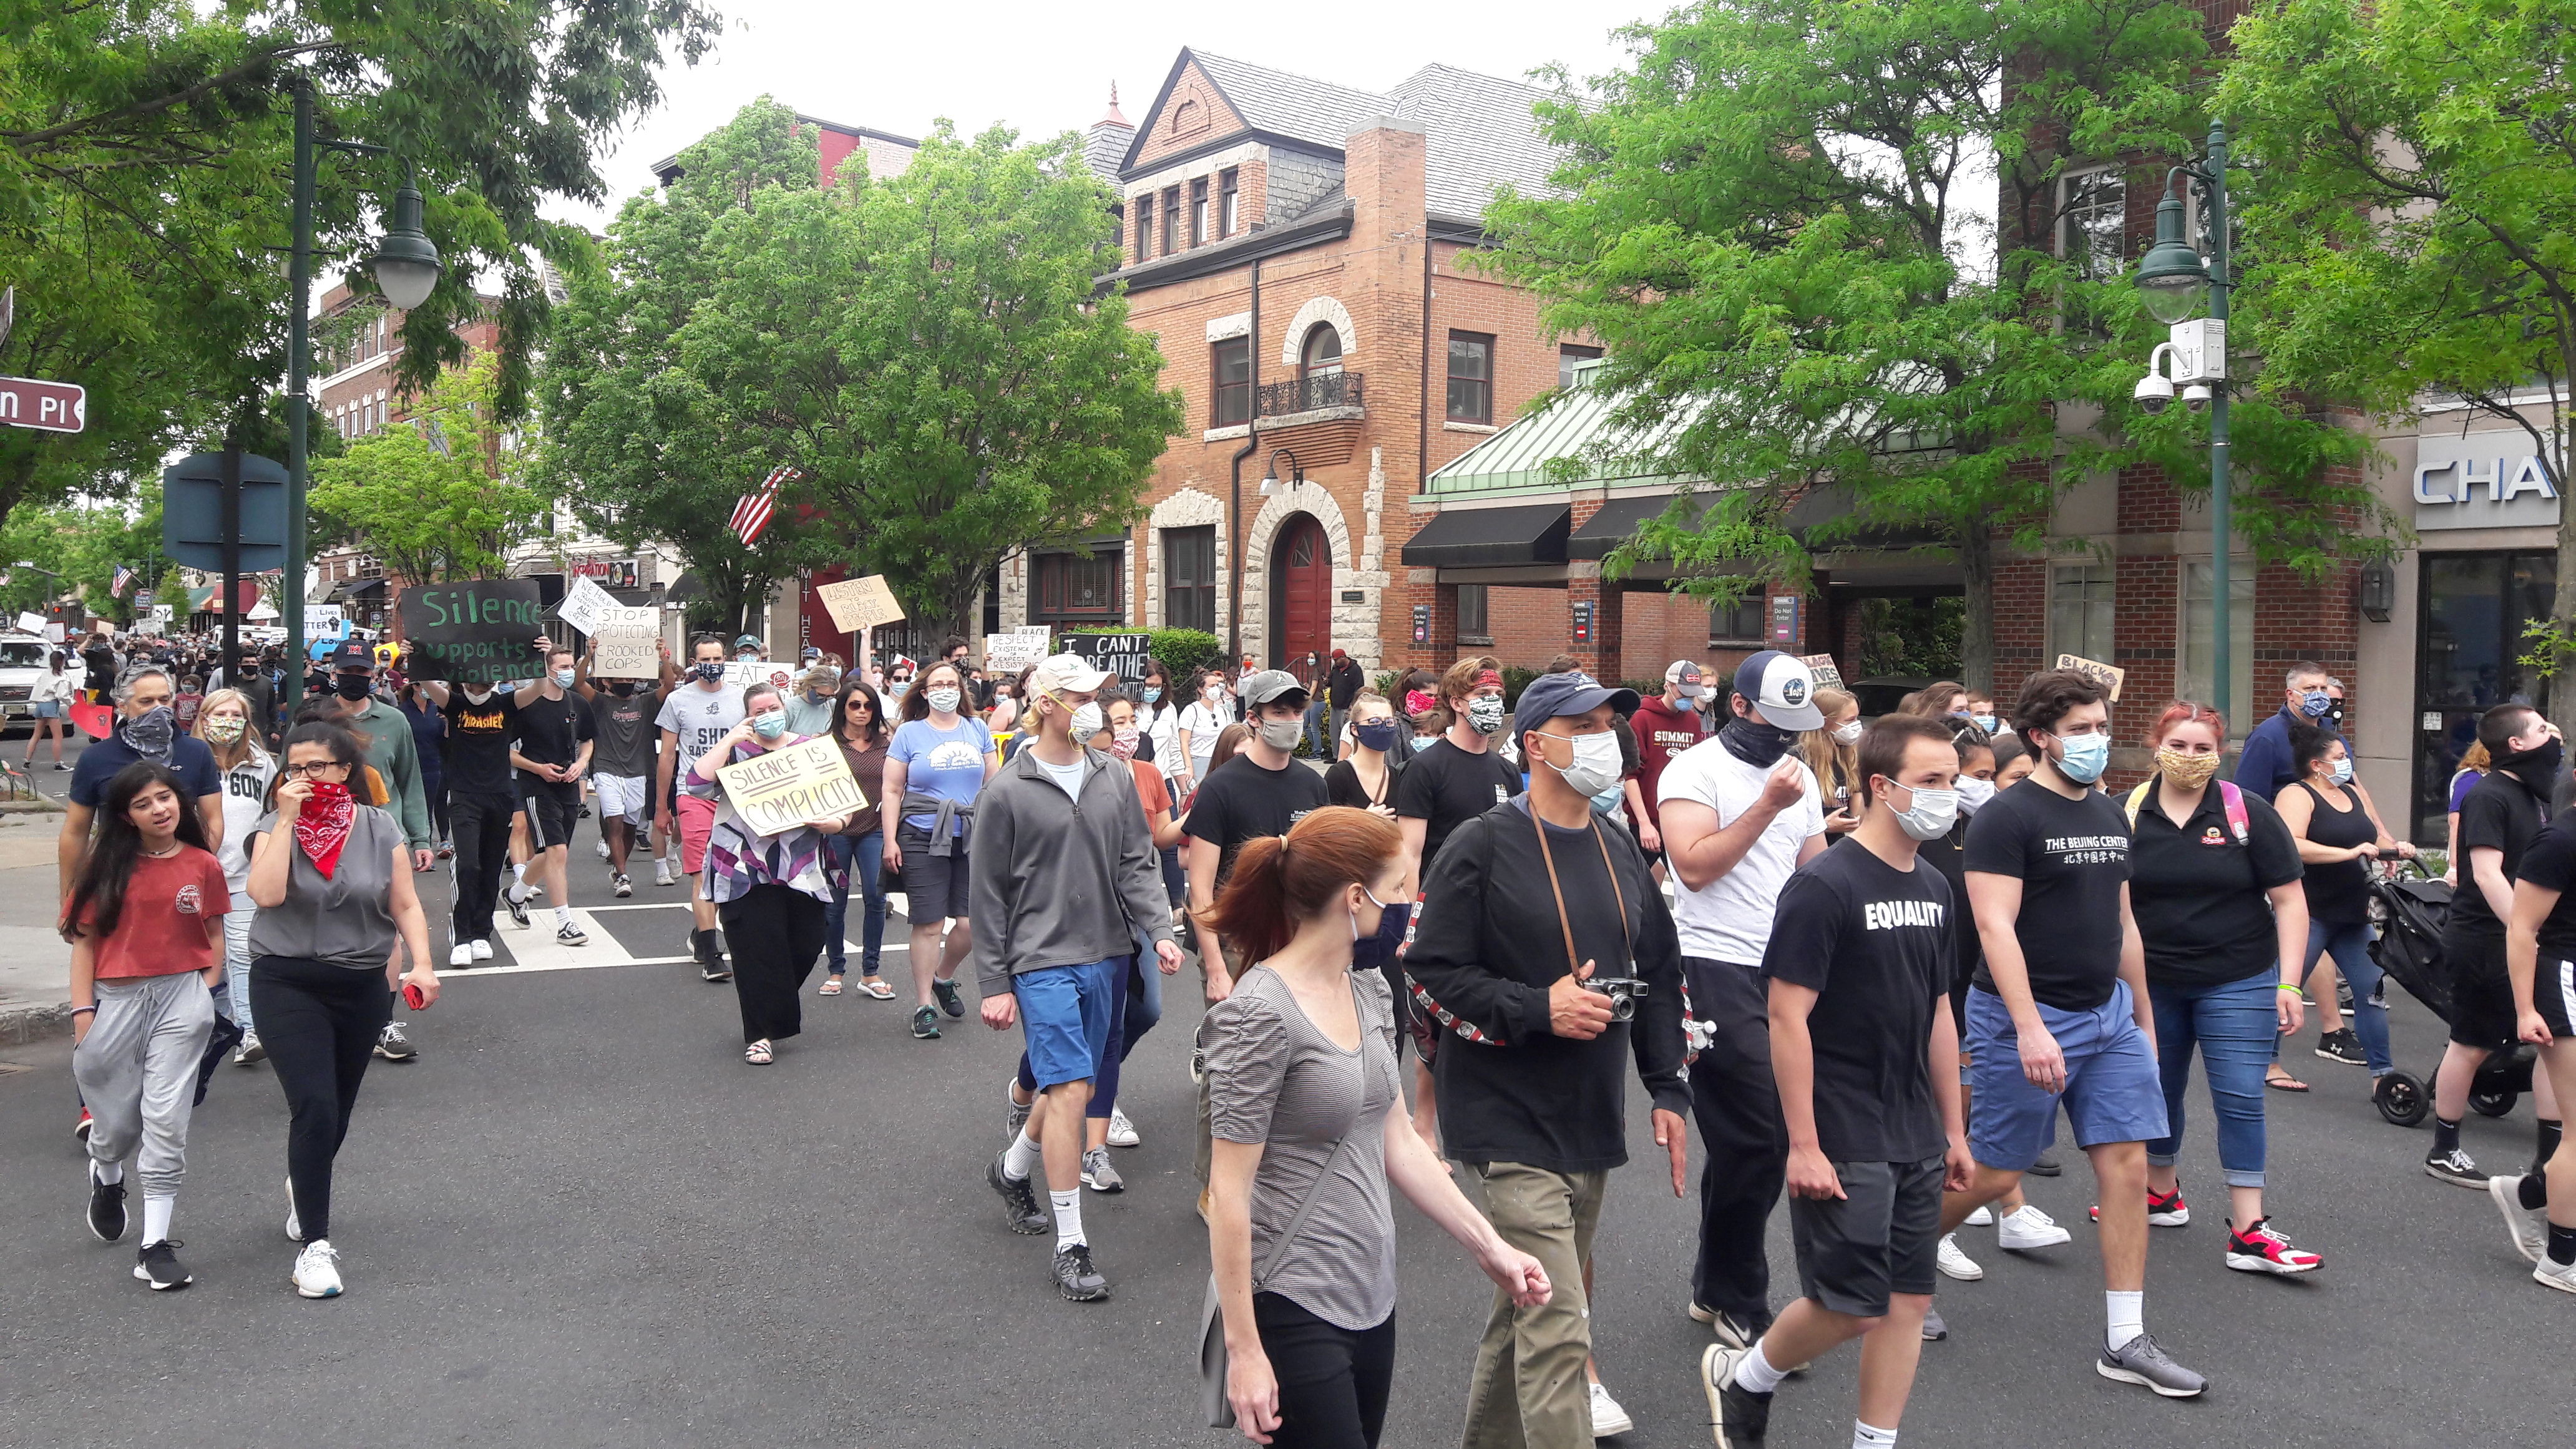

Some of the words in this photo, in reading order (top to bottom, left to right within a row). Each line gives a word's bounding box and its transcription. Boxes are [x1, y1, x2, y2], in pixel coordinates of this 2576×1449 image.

[40, 396, 66, 424] Pl
[826, 578, 874, 602] LISTEN
[422, 590, 542, 627] Silence
[602, 608, 648, 622] STOP
[596, 623, 658, 639] PROTECTING
[993, 635, 1037, 645] RESPECT
[412, 636, 527, 663] upports
[596, 645, 654, 657] CROOKED
[1064, 638, 1077, 654] I
[605, 658, 642, 670] COPS
[1086, 653, 1148, 680] REATHE
[2061, 656, 2107, 676] BLACK
[1810, 667, 1838, 682] IVES
[457, 710, 505, 729] THRASHER
[1654, 730, 1695, 743] SUMMIT
[730, 754, 798, 790] SILENCE
[805, 746, 827, 763] IS
[746, 774, 861, 829] COMPLICITY
[2045, 838, 2066, 851] THE
[2067, 836, 2099, 848] BEIJING
[2100, 836, 2129, 849] CENTER
[1865, 900, 1944, 930] EQUALITY
